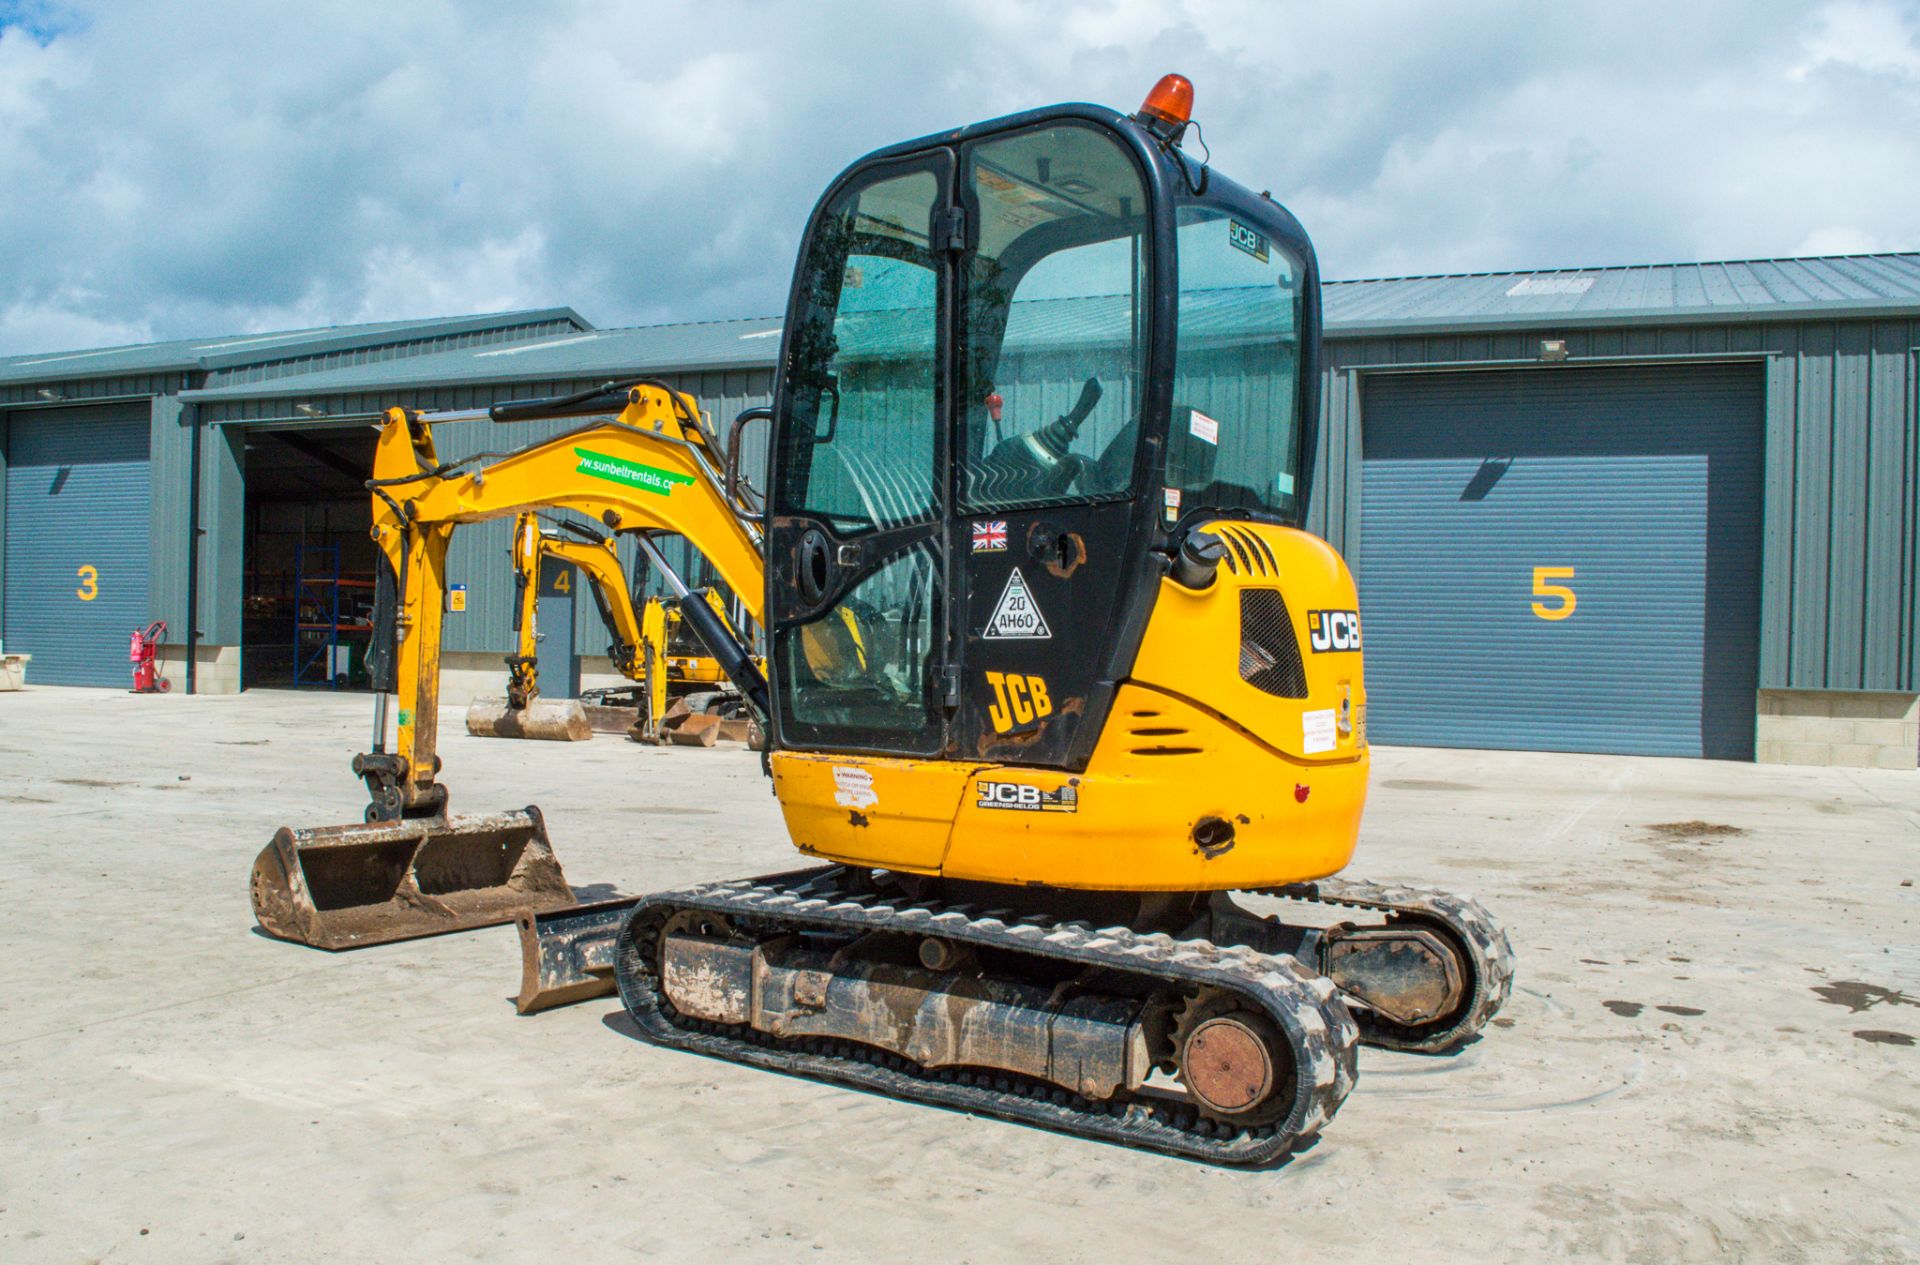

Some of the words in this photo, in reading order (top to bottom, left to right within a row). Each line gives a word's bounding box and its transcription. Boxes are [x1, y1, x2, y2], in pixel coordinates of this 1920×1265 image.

[1231, 223, 1256, 249] JCB
[77, 565, 98, 601] 3
[553, 570, 570, 594] 4
[1531, 567, 1577, 621] 5
[1009, 597, 1025, 611] 20
[999, 614, 1033, 629] AH60
[1311, 612, 1361, 650] JCB
[985, 671, 1052, 734] JCB
[979, 782, 1041, 804] JCB
